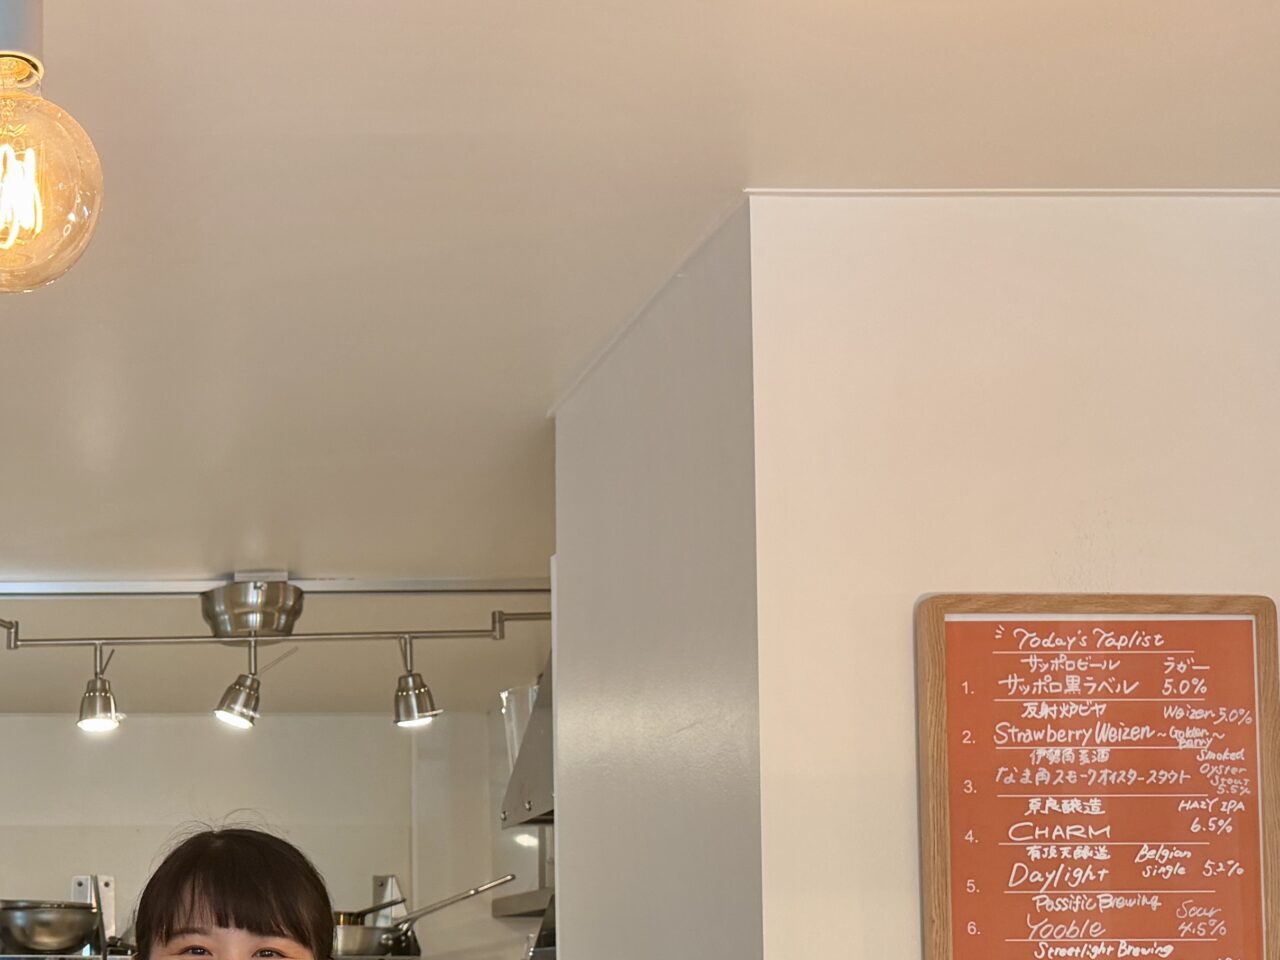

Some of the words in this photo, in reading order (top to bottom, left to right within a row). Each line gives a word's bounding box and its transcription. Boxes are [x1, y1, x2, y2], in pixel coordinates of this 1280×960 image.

[1013, 627, 1087, 650] Today's
[1093, 627, 1165, 650] Taplist
[1020, 654, 1121, 673] サッポロビール
[1162, 657, 1210, 673] ラガー
[961, 681, 975, 695] 1.
[998, 673, 1140, 695] サッポロ黒ラベル
[1161, 677, 1208, 696] 5.0%
[962, 730, 976, 744] 2.
[993, 721, 1092, 746] Strawberry
[1095, 721, 1155, 744] Weizen
[963, 780, 977, 794] 3.
[964, 829, 979, 843] 4.
[1008, 821, 1111, 842] CHARM
[1190, 816, 1233, 836] 6.5%
[1134, 844, 1192, 864] Belgian
[965, 879, 981, 893] 5.
[1008, 862, 1110, 893] Daylight
[966, 921, 981, 935] 6.
[1026, 913, 1107, 940] Yooble
